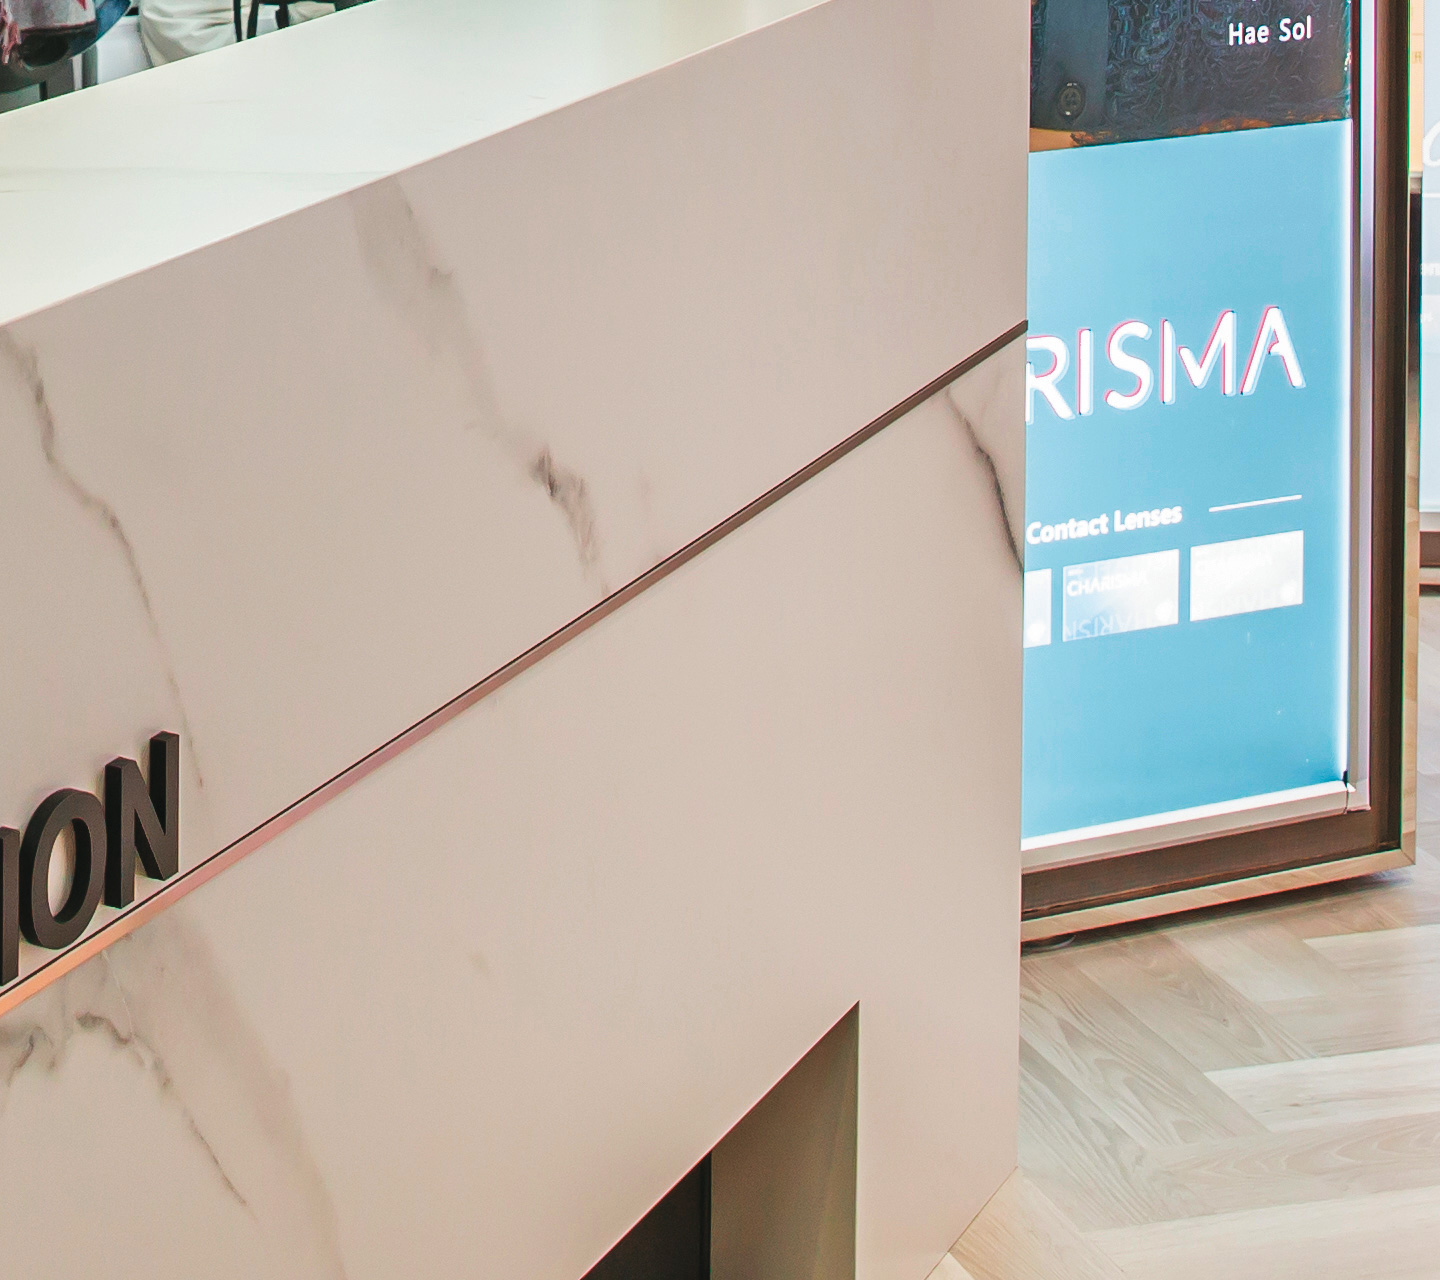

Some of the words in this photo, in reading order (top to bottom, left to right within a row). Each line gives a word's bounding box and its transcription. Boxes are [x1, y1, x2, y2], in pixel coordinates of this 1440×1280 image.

[1228, 22, 1270, 46] Hae
[1278, 14, 1312, 42] Sol
[1025, 304, 1307, 426] RISMA
[1026, 512, 1110, 545] Contact
[1113, 505, 1183, 533] Lenses
